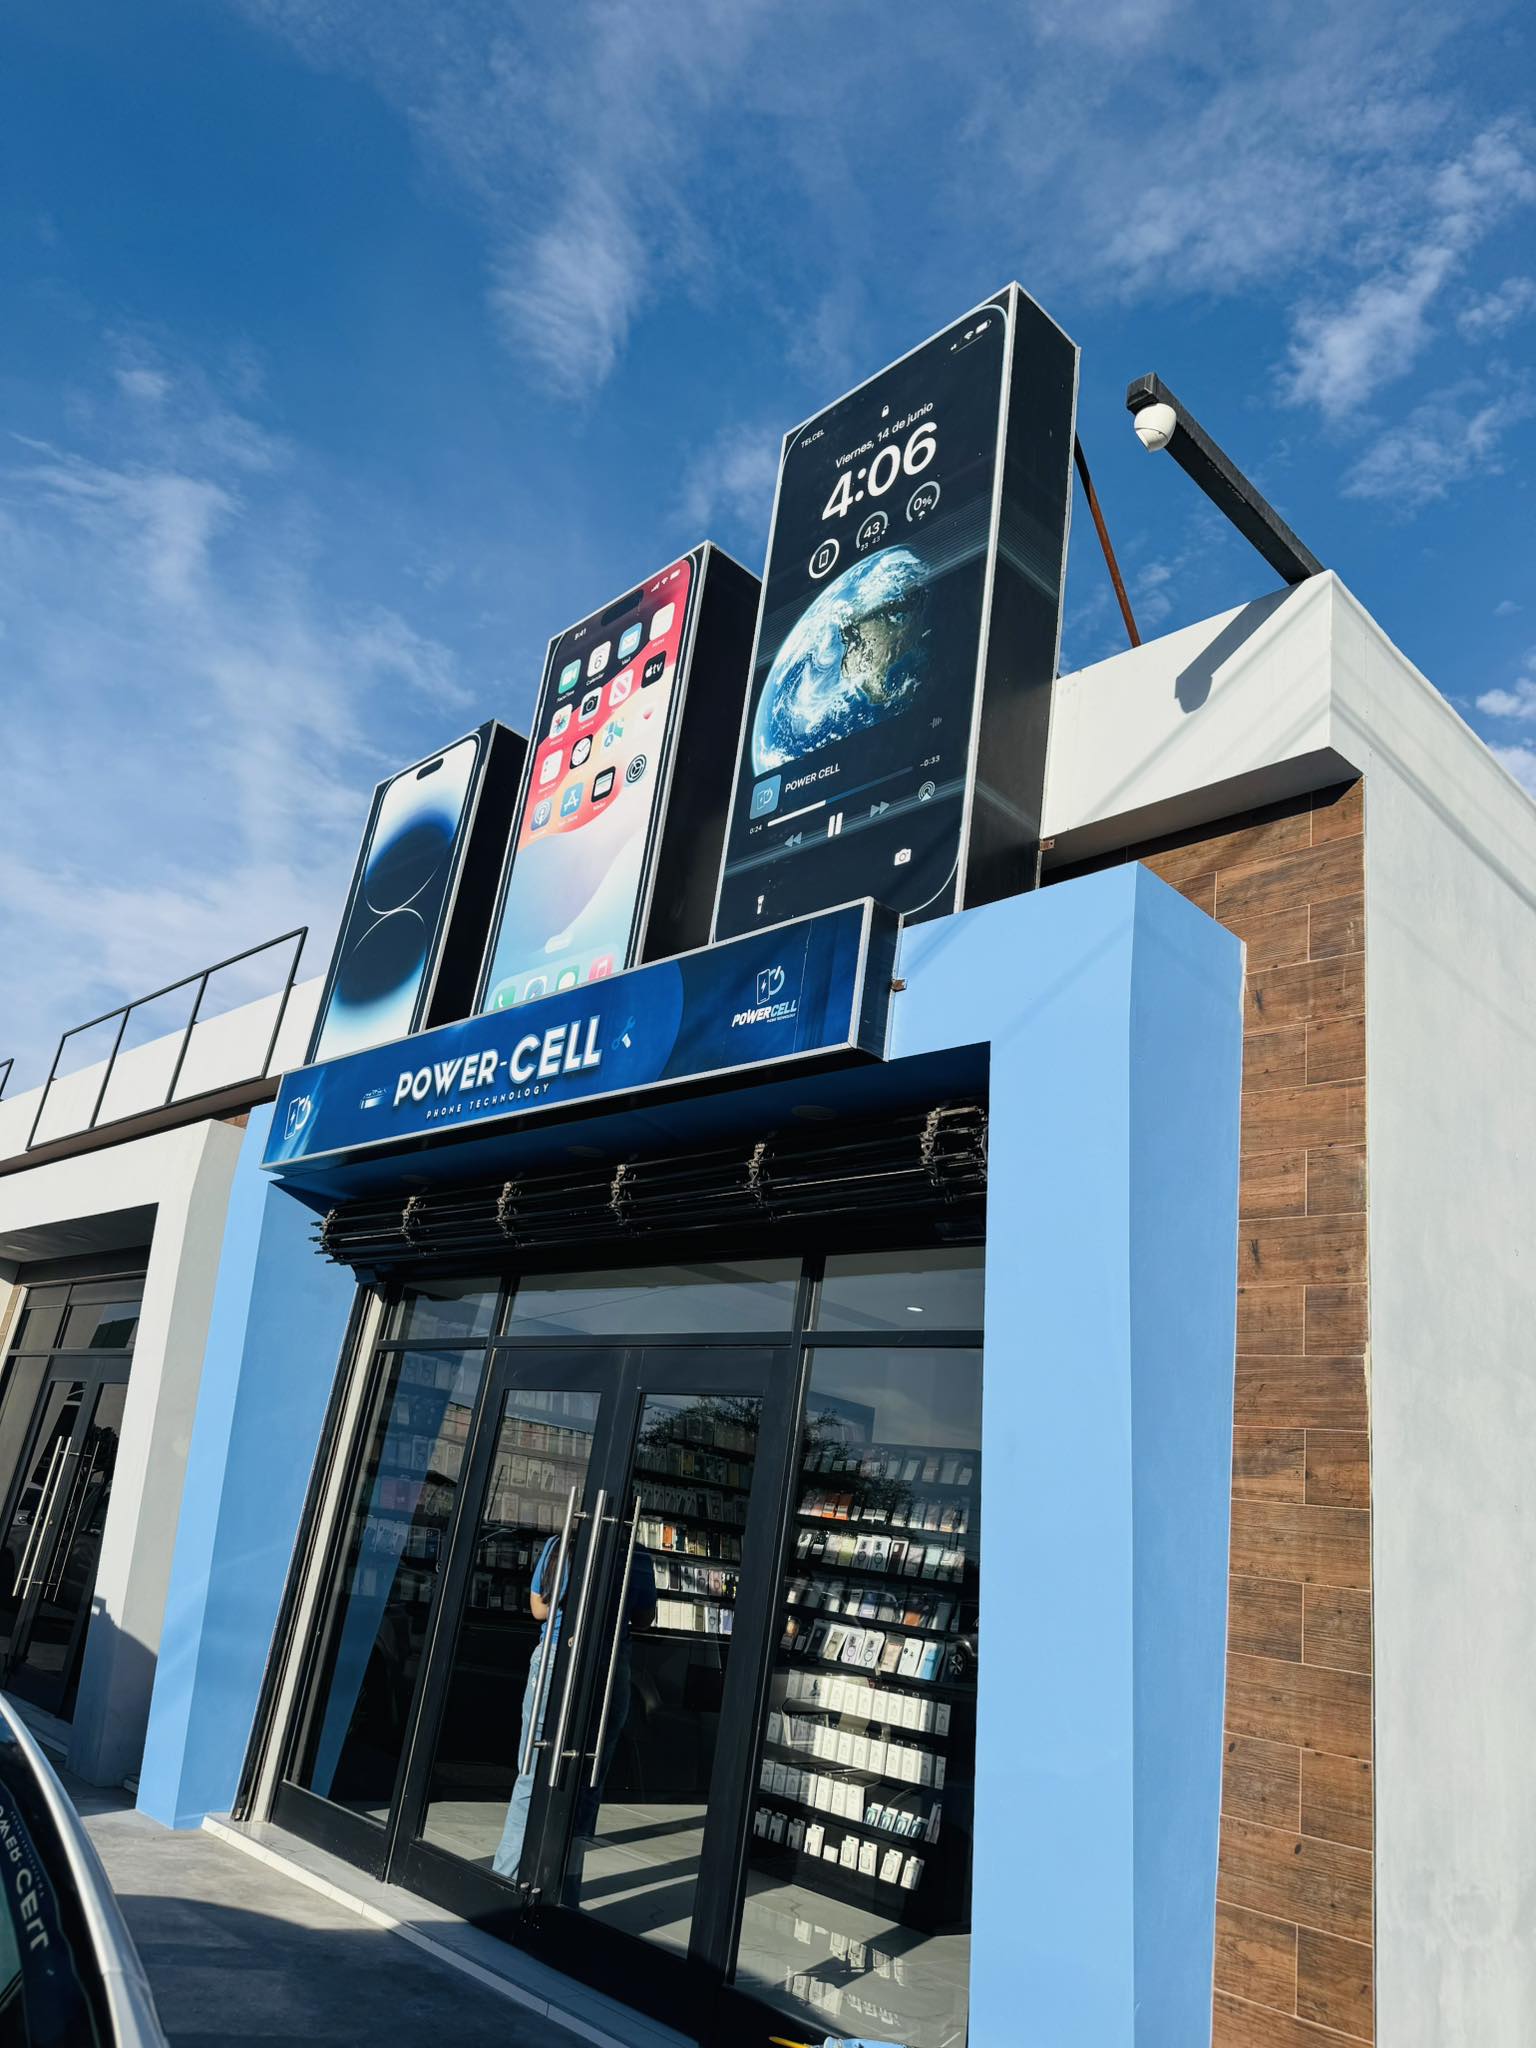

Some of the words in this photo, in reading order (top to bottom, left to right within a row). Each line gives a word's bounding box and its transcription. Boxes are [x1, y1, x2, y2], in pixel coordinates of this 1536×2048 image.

[801, 429, 825, 449] TELCEL
[835, 440, 875, 468] Viernes,
[877, 427, 890, 442] 14
[892, 419, 906, 433] de
[906, 402, 934, 427] junio
[822, 421, 938, 520] 4:06
[913, 495, 933, 511] 0%
[863, 521, 881, 539] 43
[784, 772, 817, 793] POWER
[818, 763, 841, 780] CELL
[731, 999, 797, 1028] POWERCELL
[426, 1104, 463, 1120] PHONE
[469, 1082, 551, 1110] TECHNOLOGY
